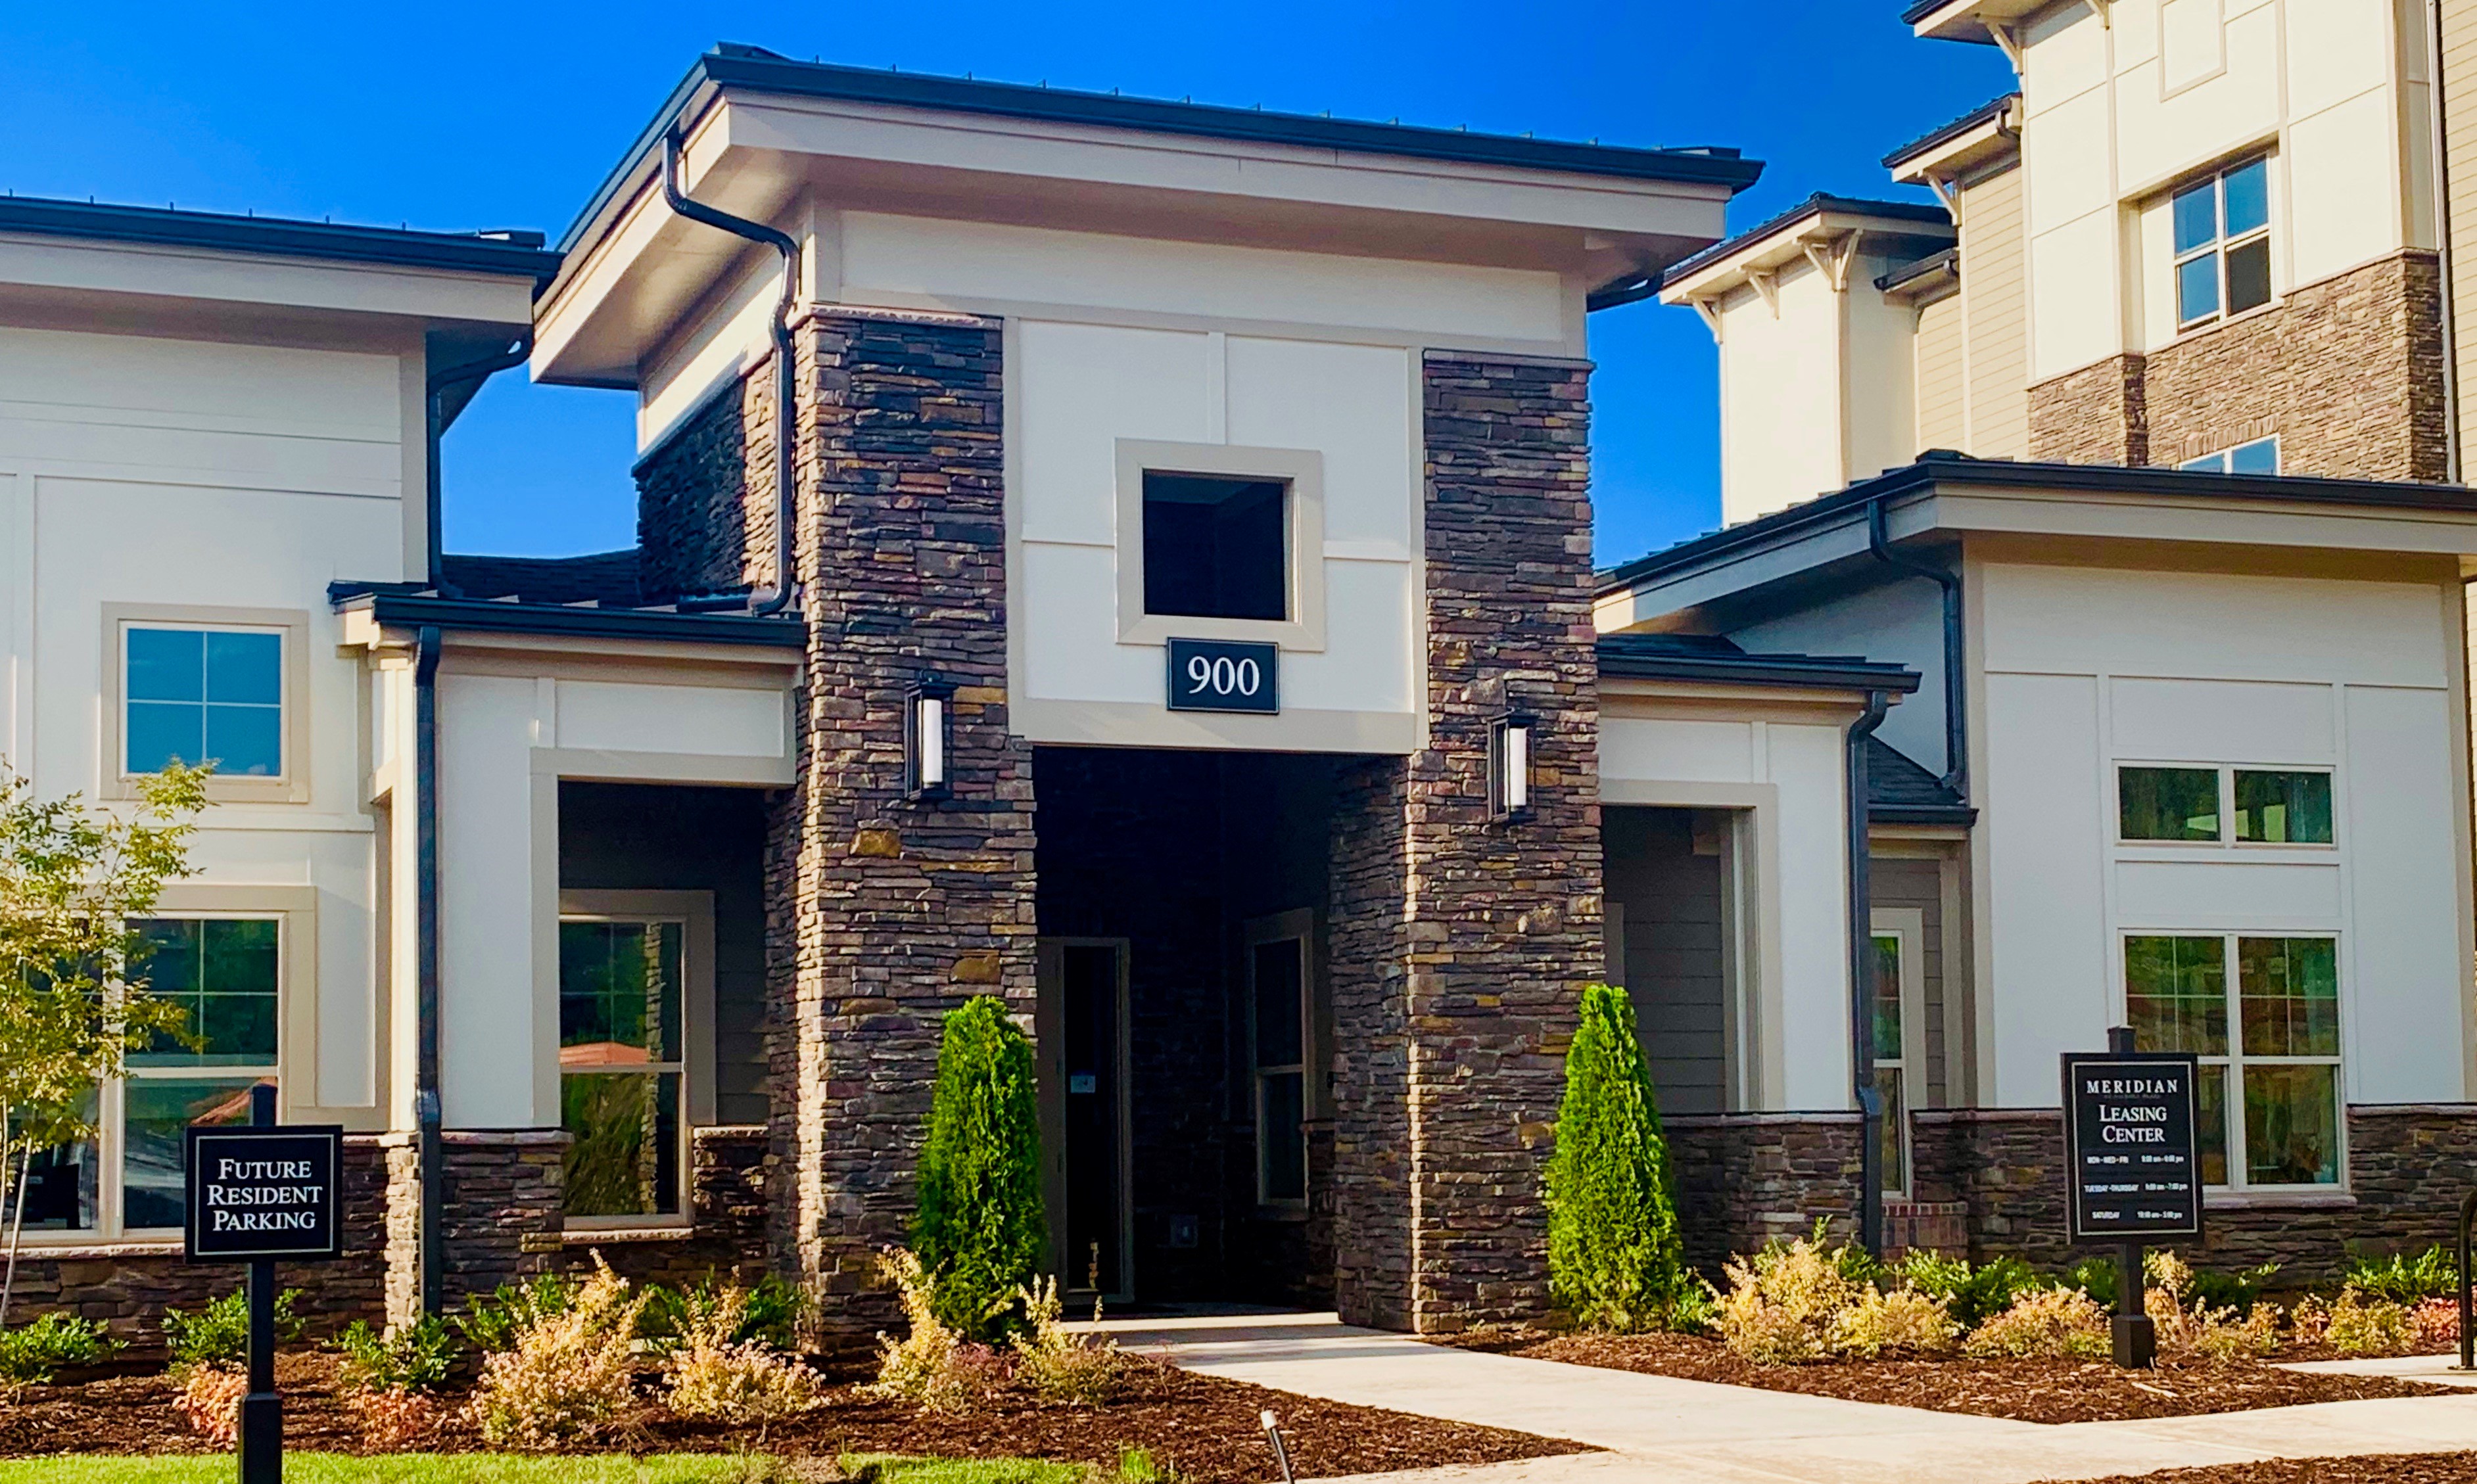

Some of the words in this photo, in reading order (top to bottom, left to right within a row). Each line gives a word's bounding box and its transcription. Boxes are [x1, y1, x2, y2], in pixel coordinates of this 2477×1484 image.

[1188, 656, 1260, 696] 900
[2087, 1079, 2178, 1094] MERIDIAN
[2099, 1104, 2167, 1122] LEASING
[2102, 1125, 2165, 1143] CENTER
[218, 1159, 312, 1180] FUTURE
[206, 1185, 323, 1206] RESIDENT
[212, 1210, 316, 1231] PARKING
